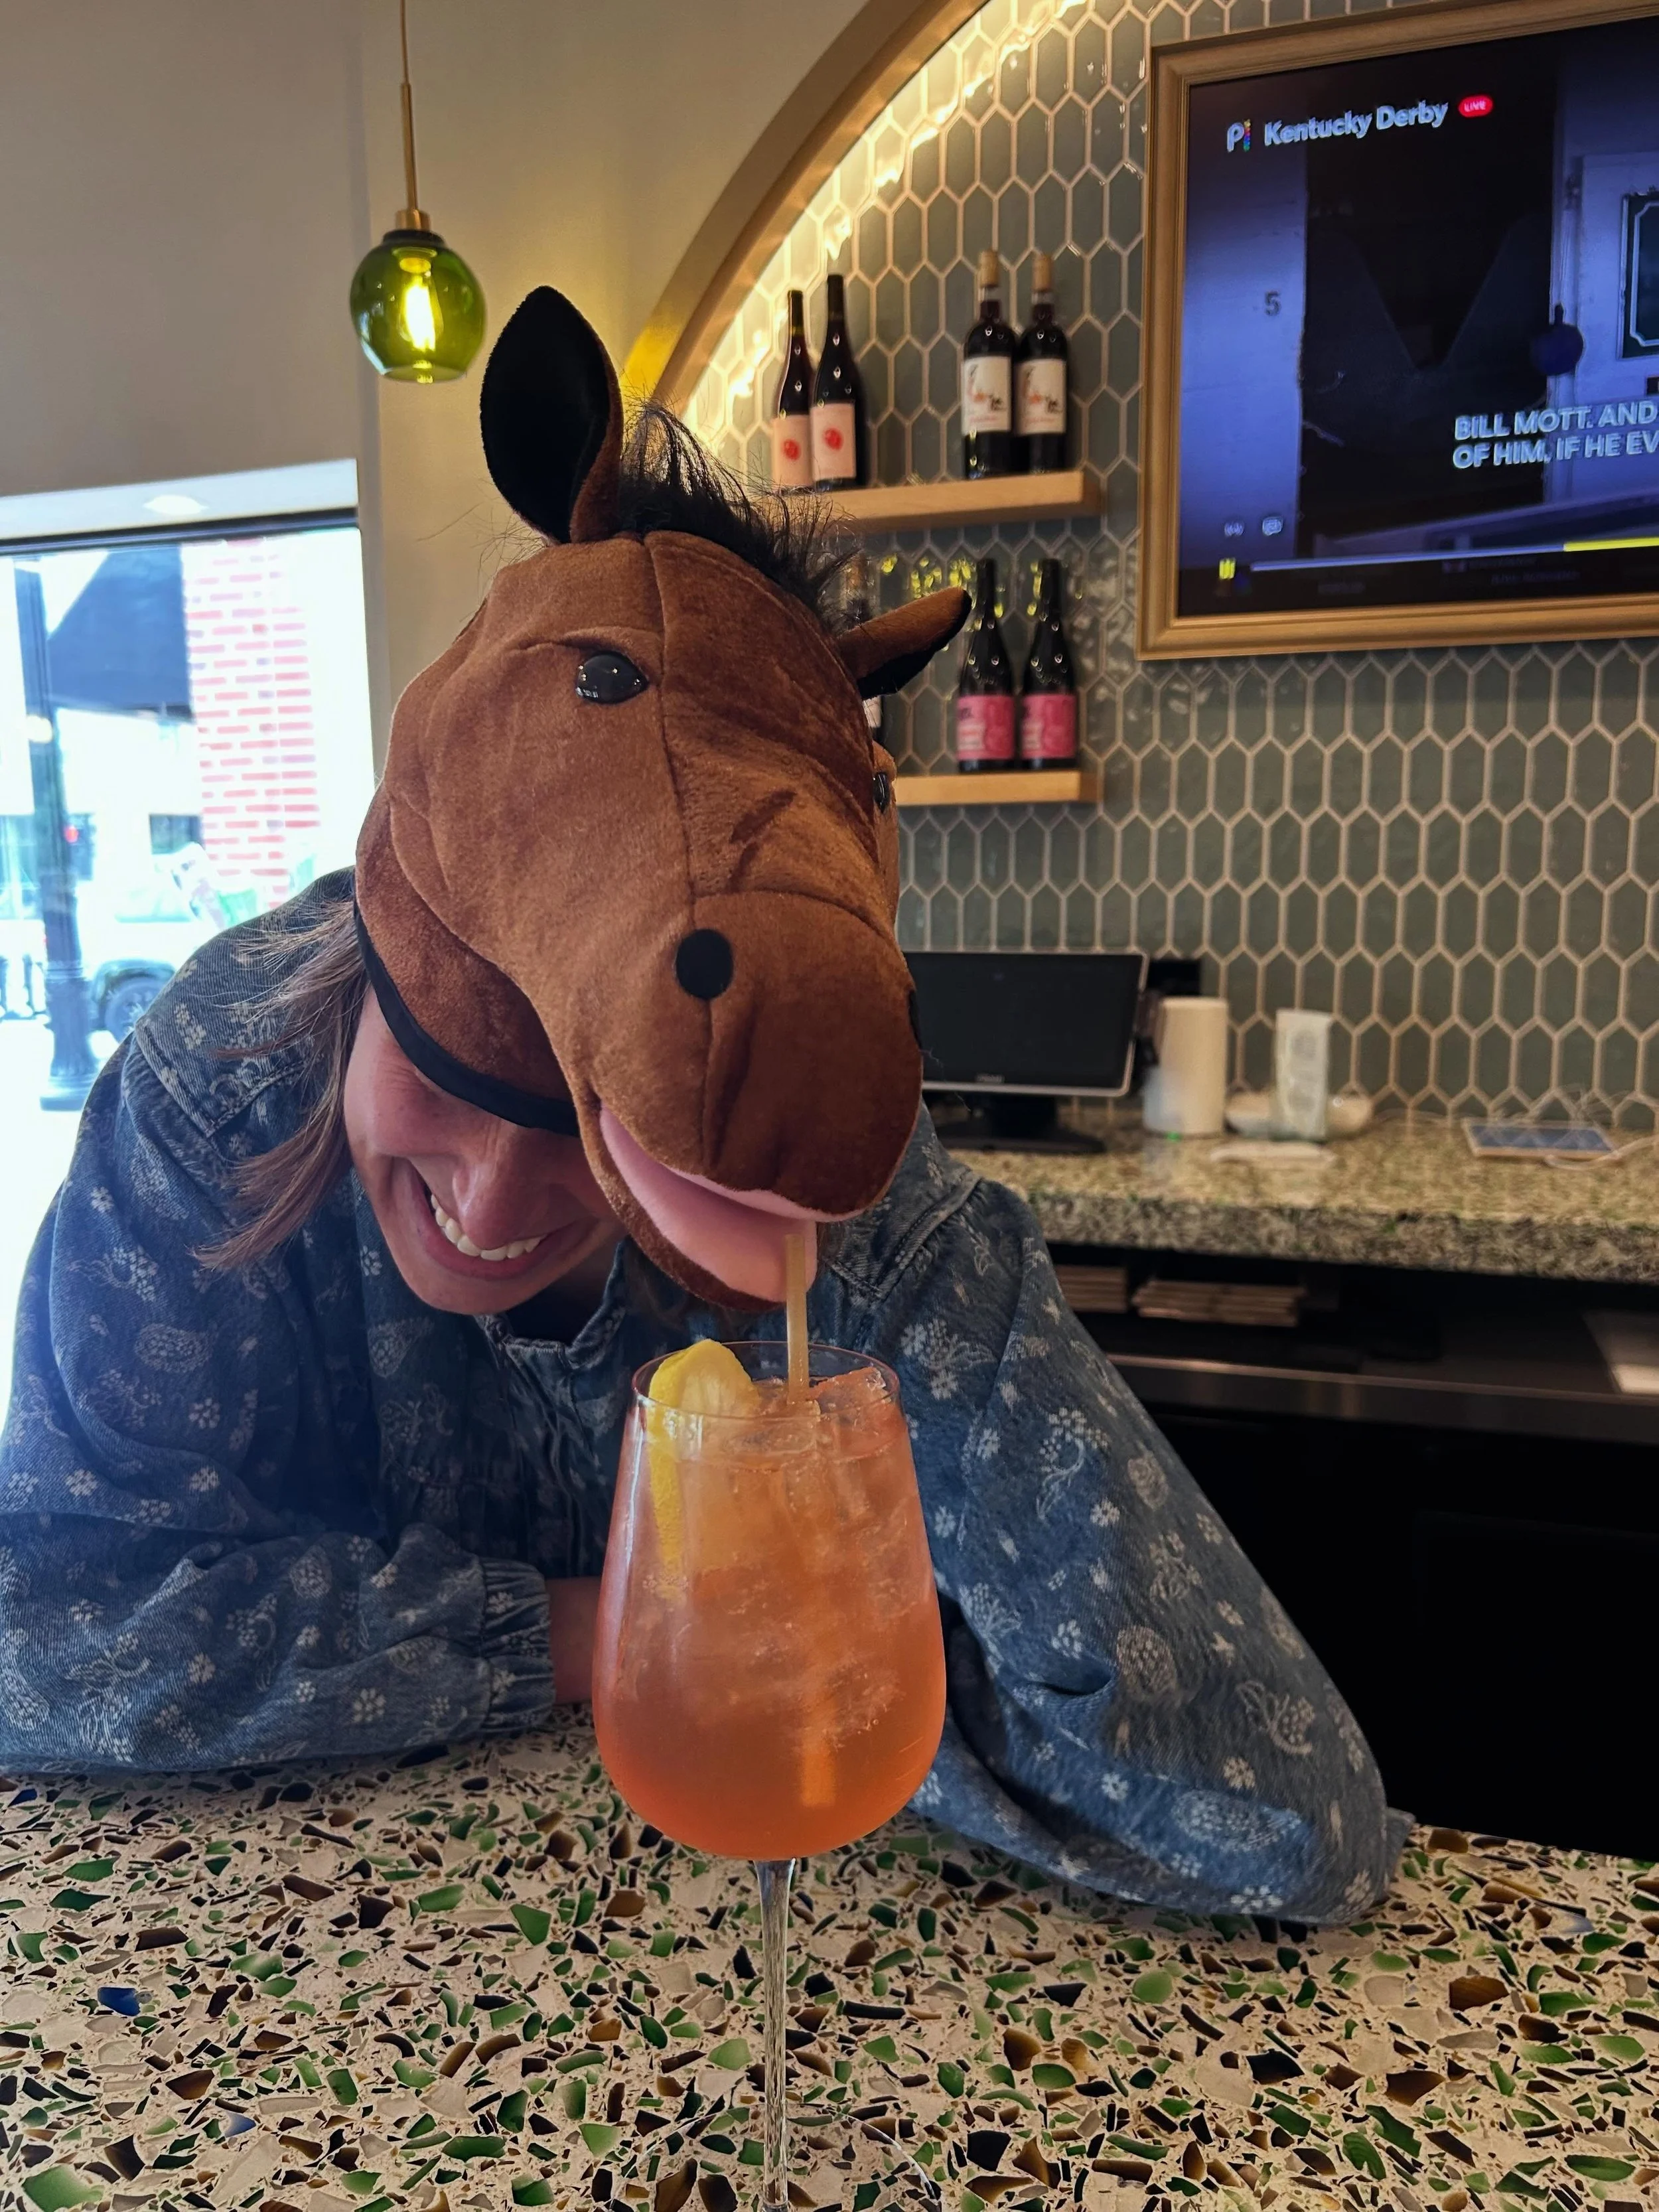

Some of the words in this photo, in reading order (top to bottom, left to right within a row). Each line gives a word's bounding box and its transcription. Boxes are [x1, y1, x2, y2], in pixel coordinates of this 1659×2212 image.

[1265, 111, 1372, 146] Kentucky
[1376, 100, 1449, 130] Derby
[1464, 100, 1486, 112] LIVE
[1264, 290, 1281, 317] 5
[1455, 413, 1510, 441] BILL
[1597, 400, 1658, 428] AND
[1453, 443, 1490, 469] OF
[1493, 439, 1553, 466] HIM,
[1556, 435, 1581, 460] IF
[1584, 432, 1621, 458] HE
